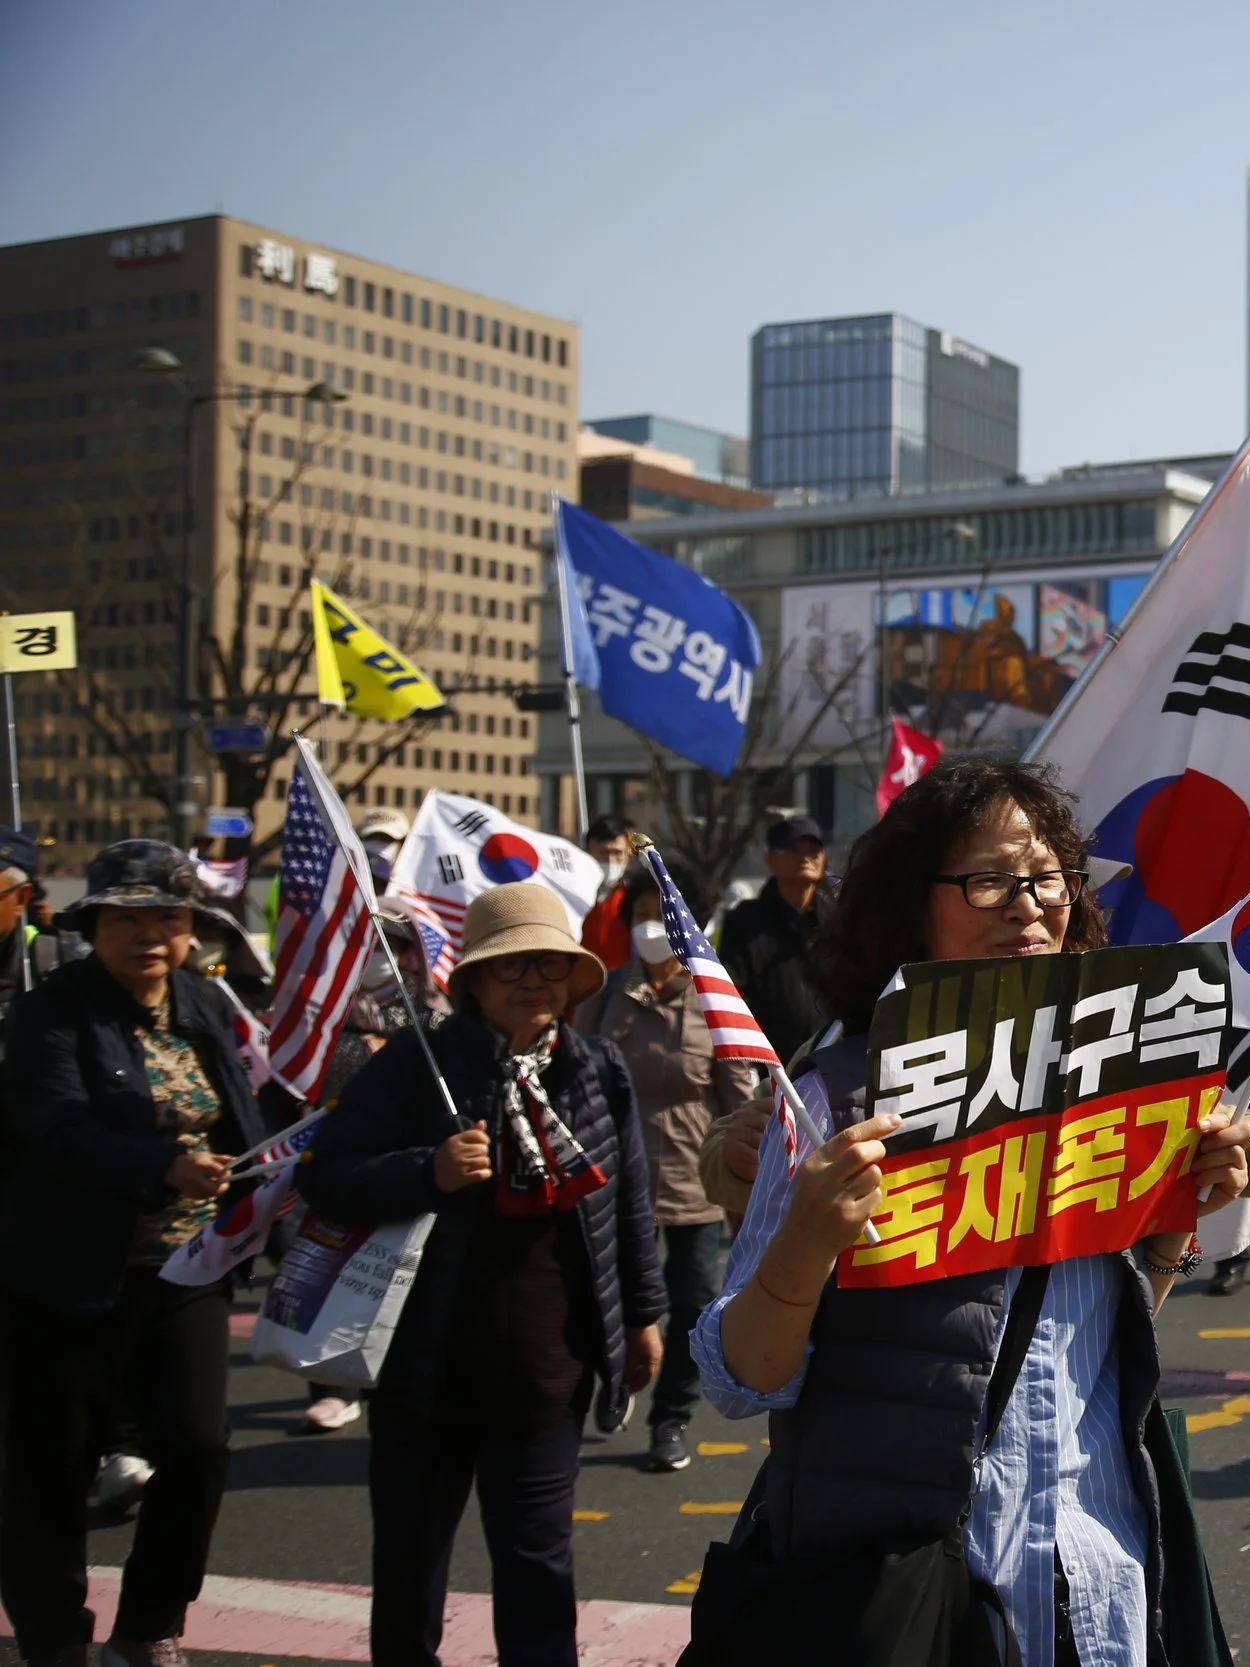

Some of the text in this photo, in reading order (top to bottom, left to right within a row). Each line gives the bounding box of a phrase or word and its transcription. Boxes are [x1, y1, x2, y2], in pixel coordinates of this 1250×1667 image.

[12, 626, 57, 656] 경
[874, 968, 1227, 1142] 목사구속
[851, 1086, 1223, 1269] 독재폭거
[339, 1272, 367, 1294] ving
